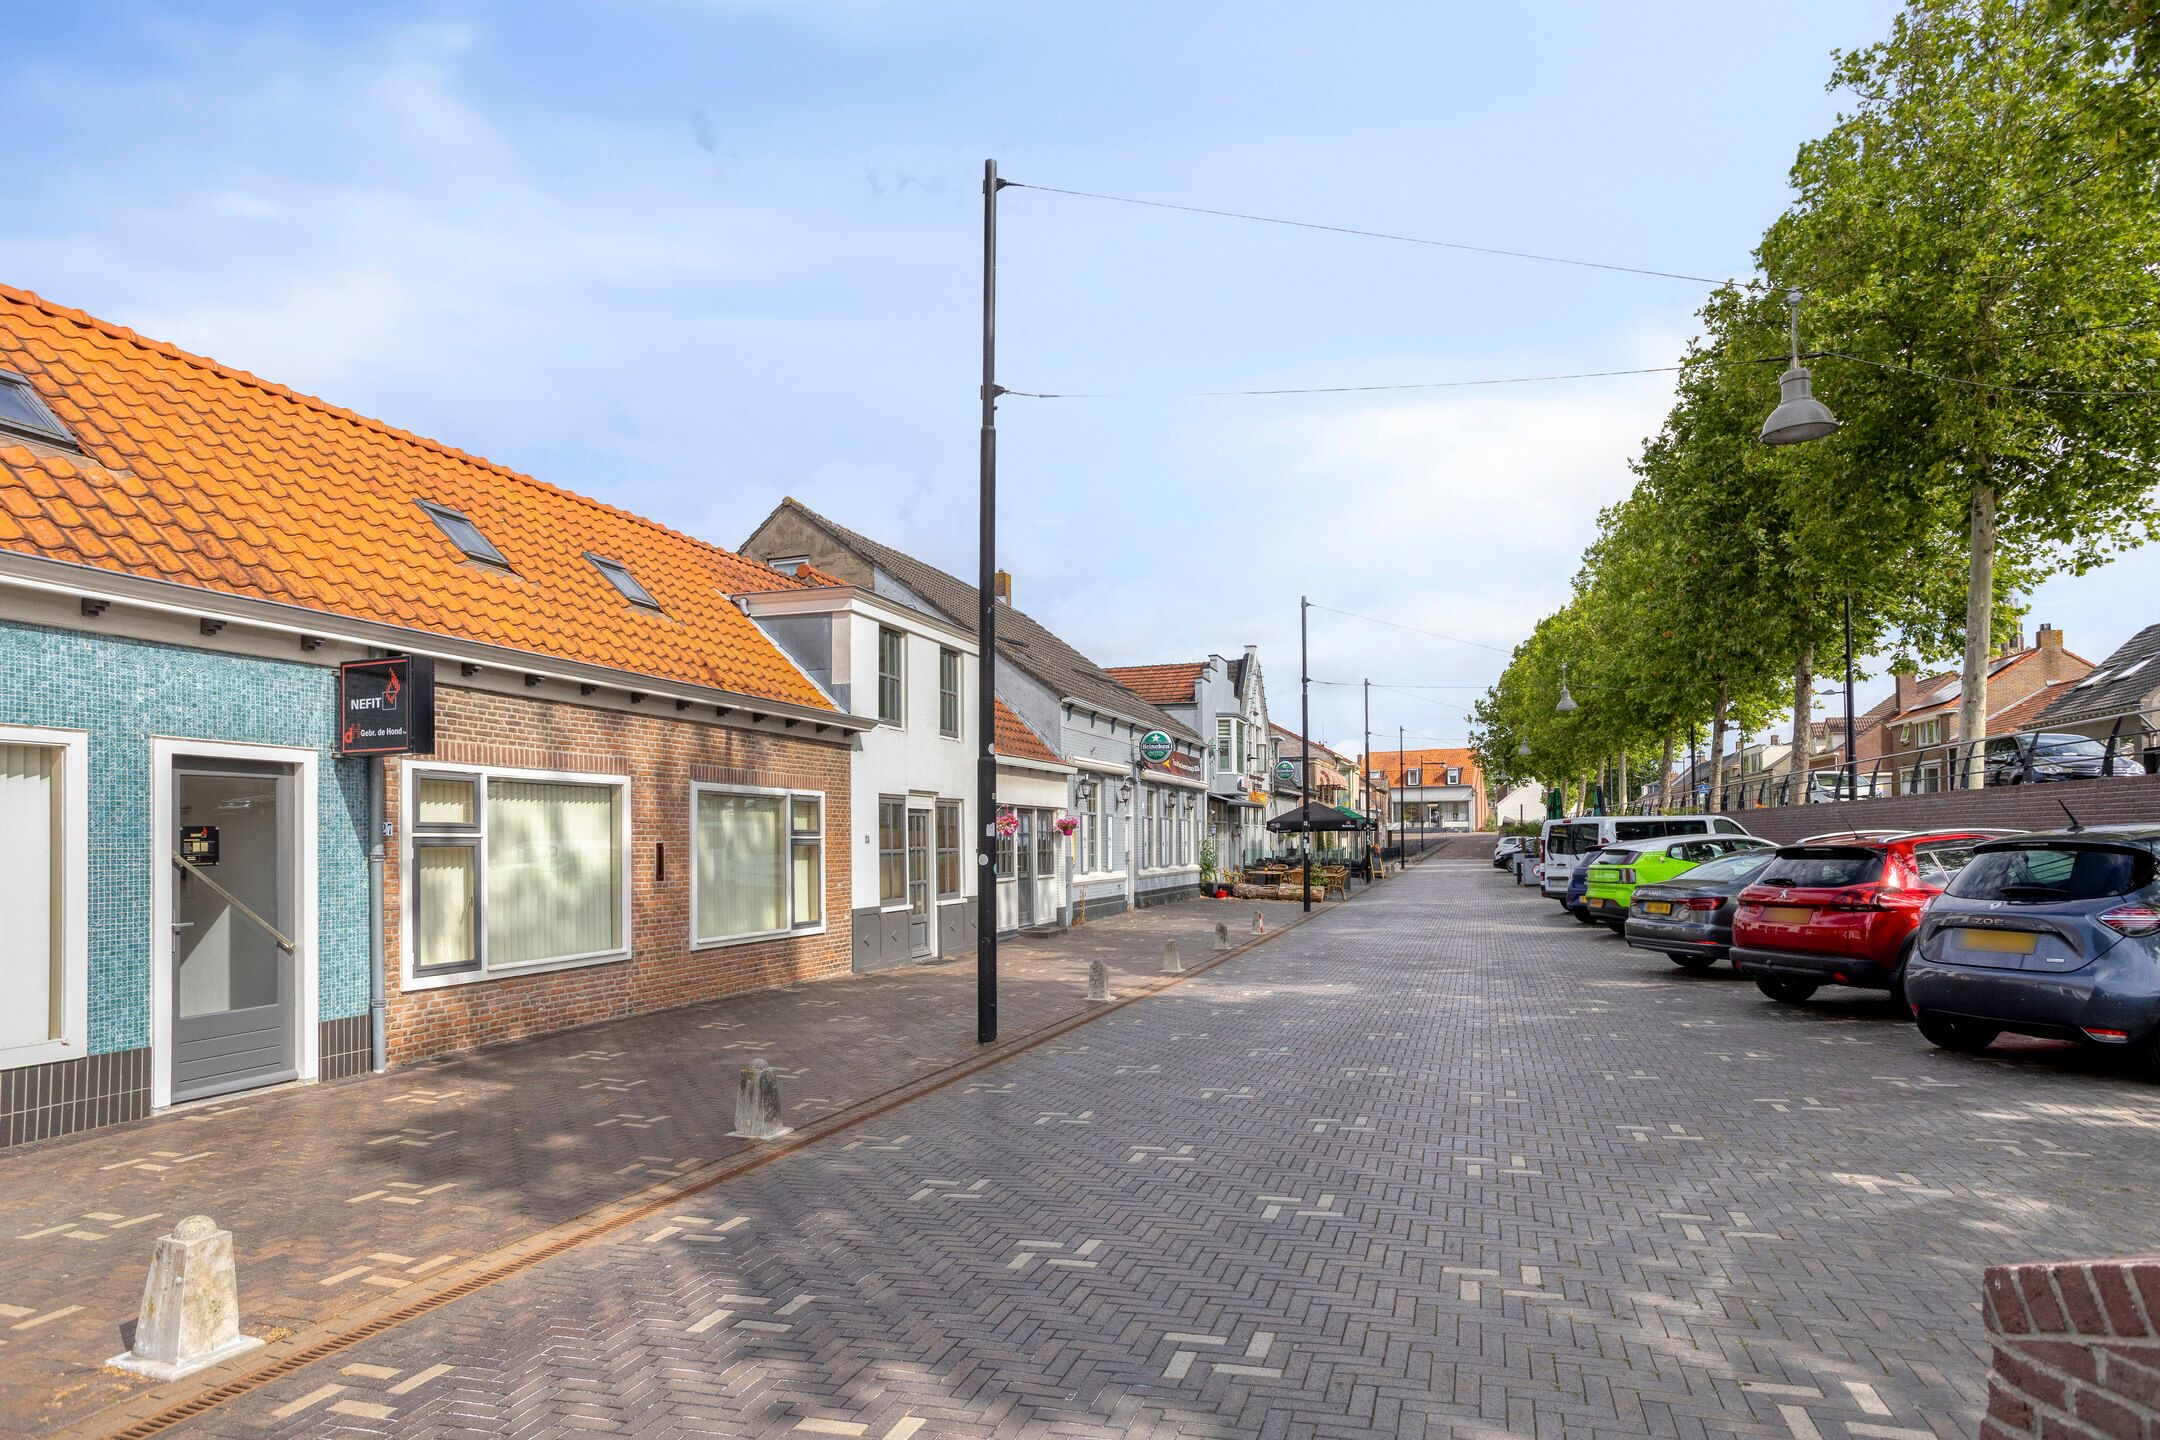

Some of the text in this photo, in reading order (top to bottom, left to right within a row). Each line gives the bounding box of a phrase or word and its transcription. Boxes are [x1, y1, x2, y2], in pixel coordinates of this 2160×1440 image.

[351, 698, 381, 710] NEFIT
[361, 729, 376, 737] Gebr.
[377, 728, 385, 736] de
[386, 727, 402, 735] Hond
[1974, 917, 2004, 926] ZOE
